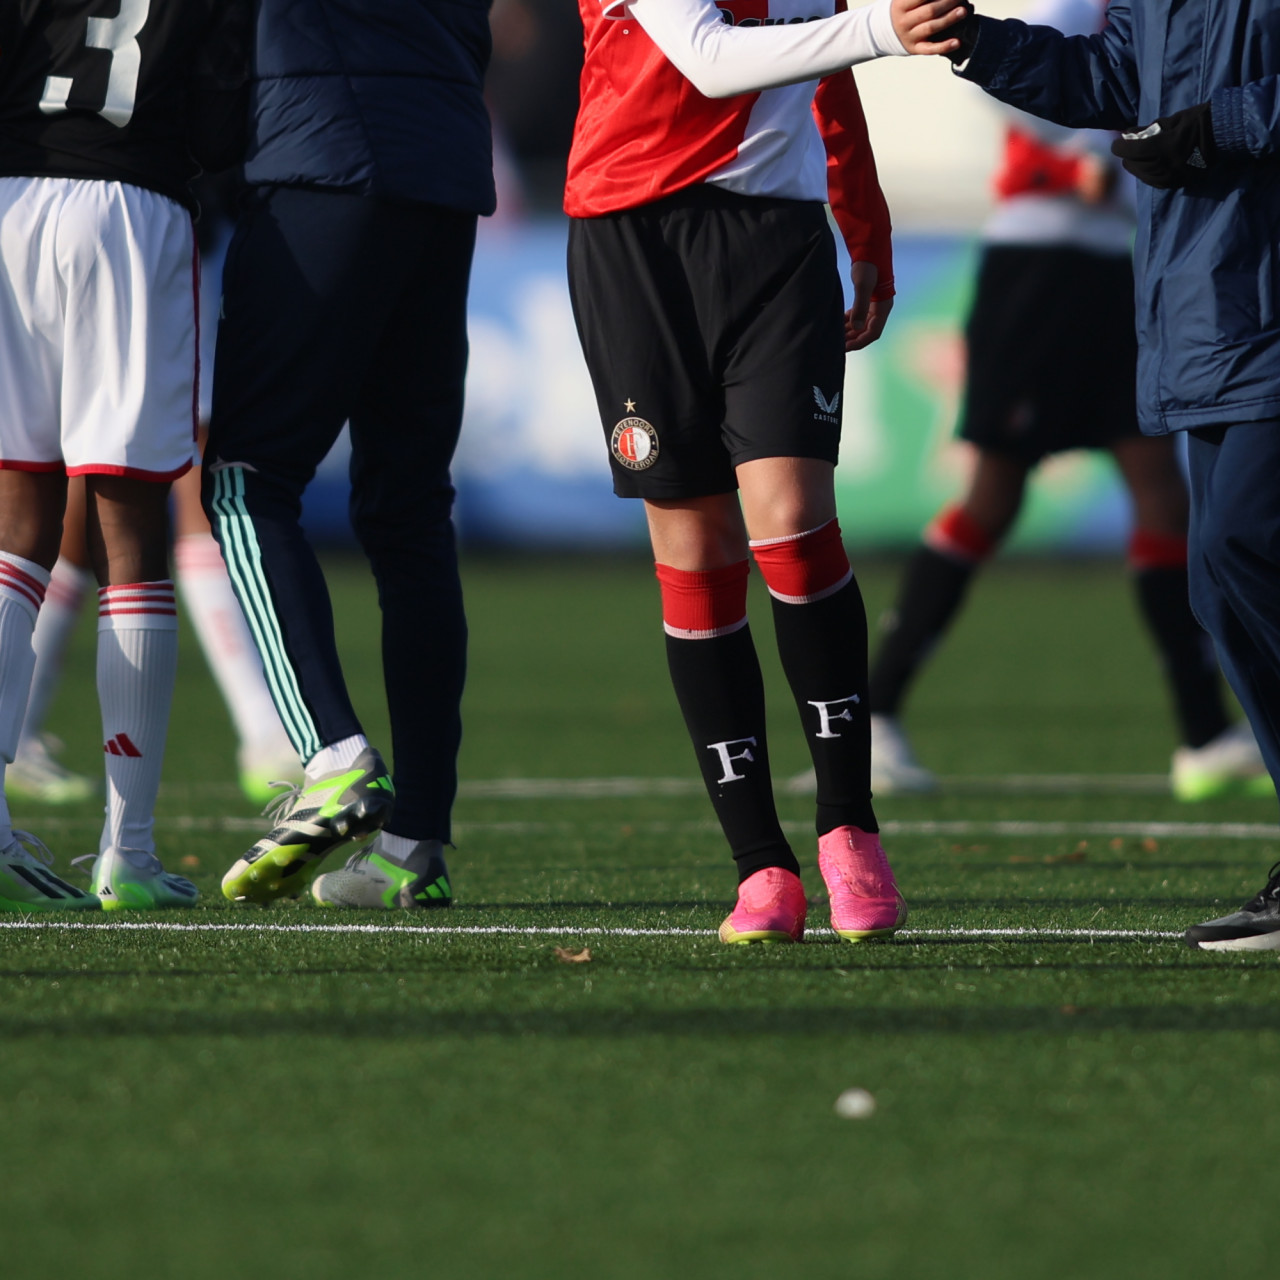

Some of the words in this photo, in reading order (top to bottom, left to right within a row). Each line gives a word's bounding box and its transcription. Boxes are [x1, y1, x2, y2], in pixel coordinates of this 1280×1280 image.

[613, 419, 654, 438] FEYENOORD
[615, 449, 658, 469] ROTTERDAM
[807, 693, 860, 739] F
[706, 736, 757, 785] F
